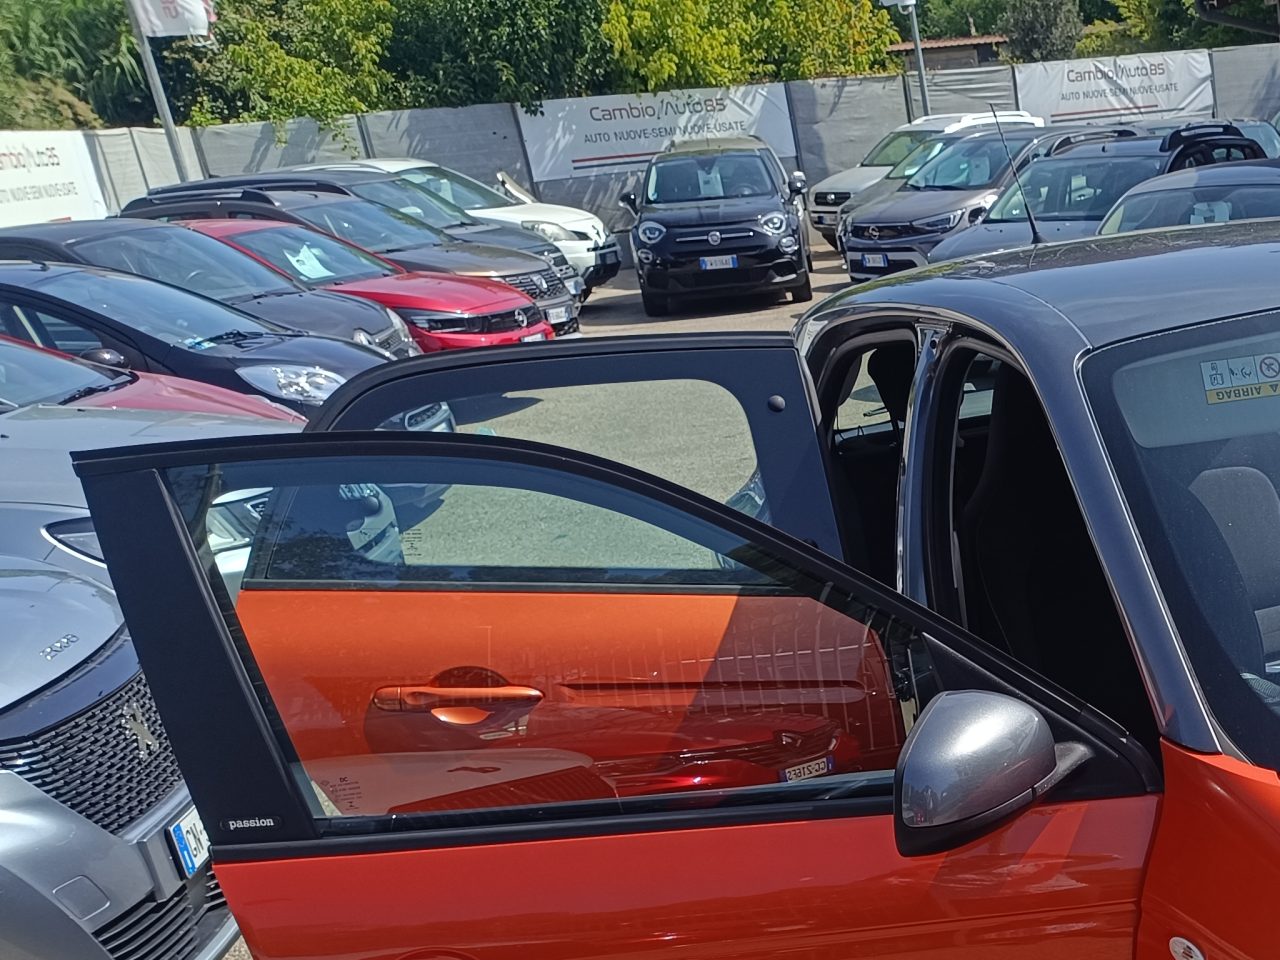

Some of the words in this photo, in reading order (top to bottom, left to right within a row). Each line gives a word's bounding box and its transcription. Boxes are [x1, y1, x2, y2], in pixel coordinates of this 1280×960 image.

[584, 131, 610, 144] AUTO
[1216, 385, 1262, 401] AIRBAG
[228, 817, 274, 830] passion
